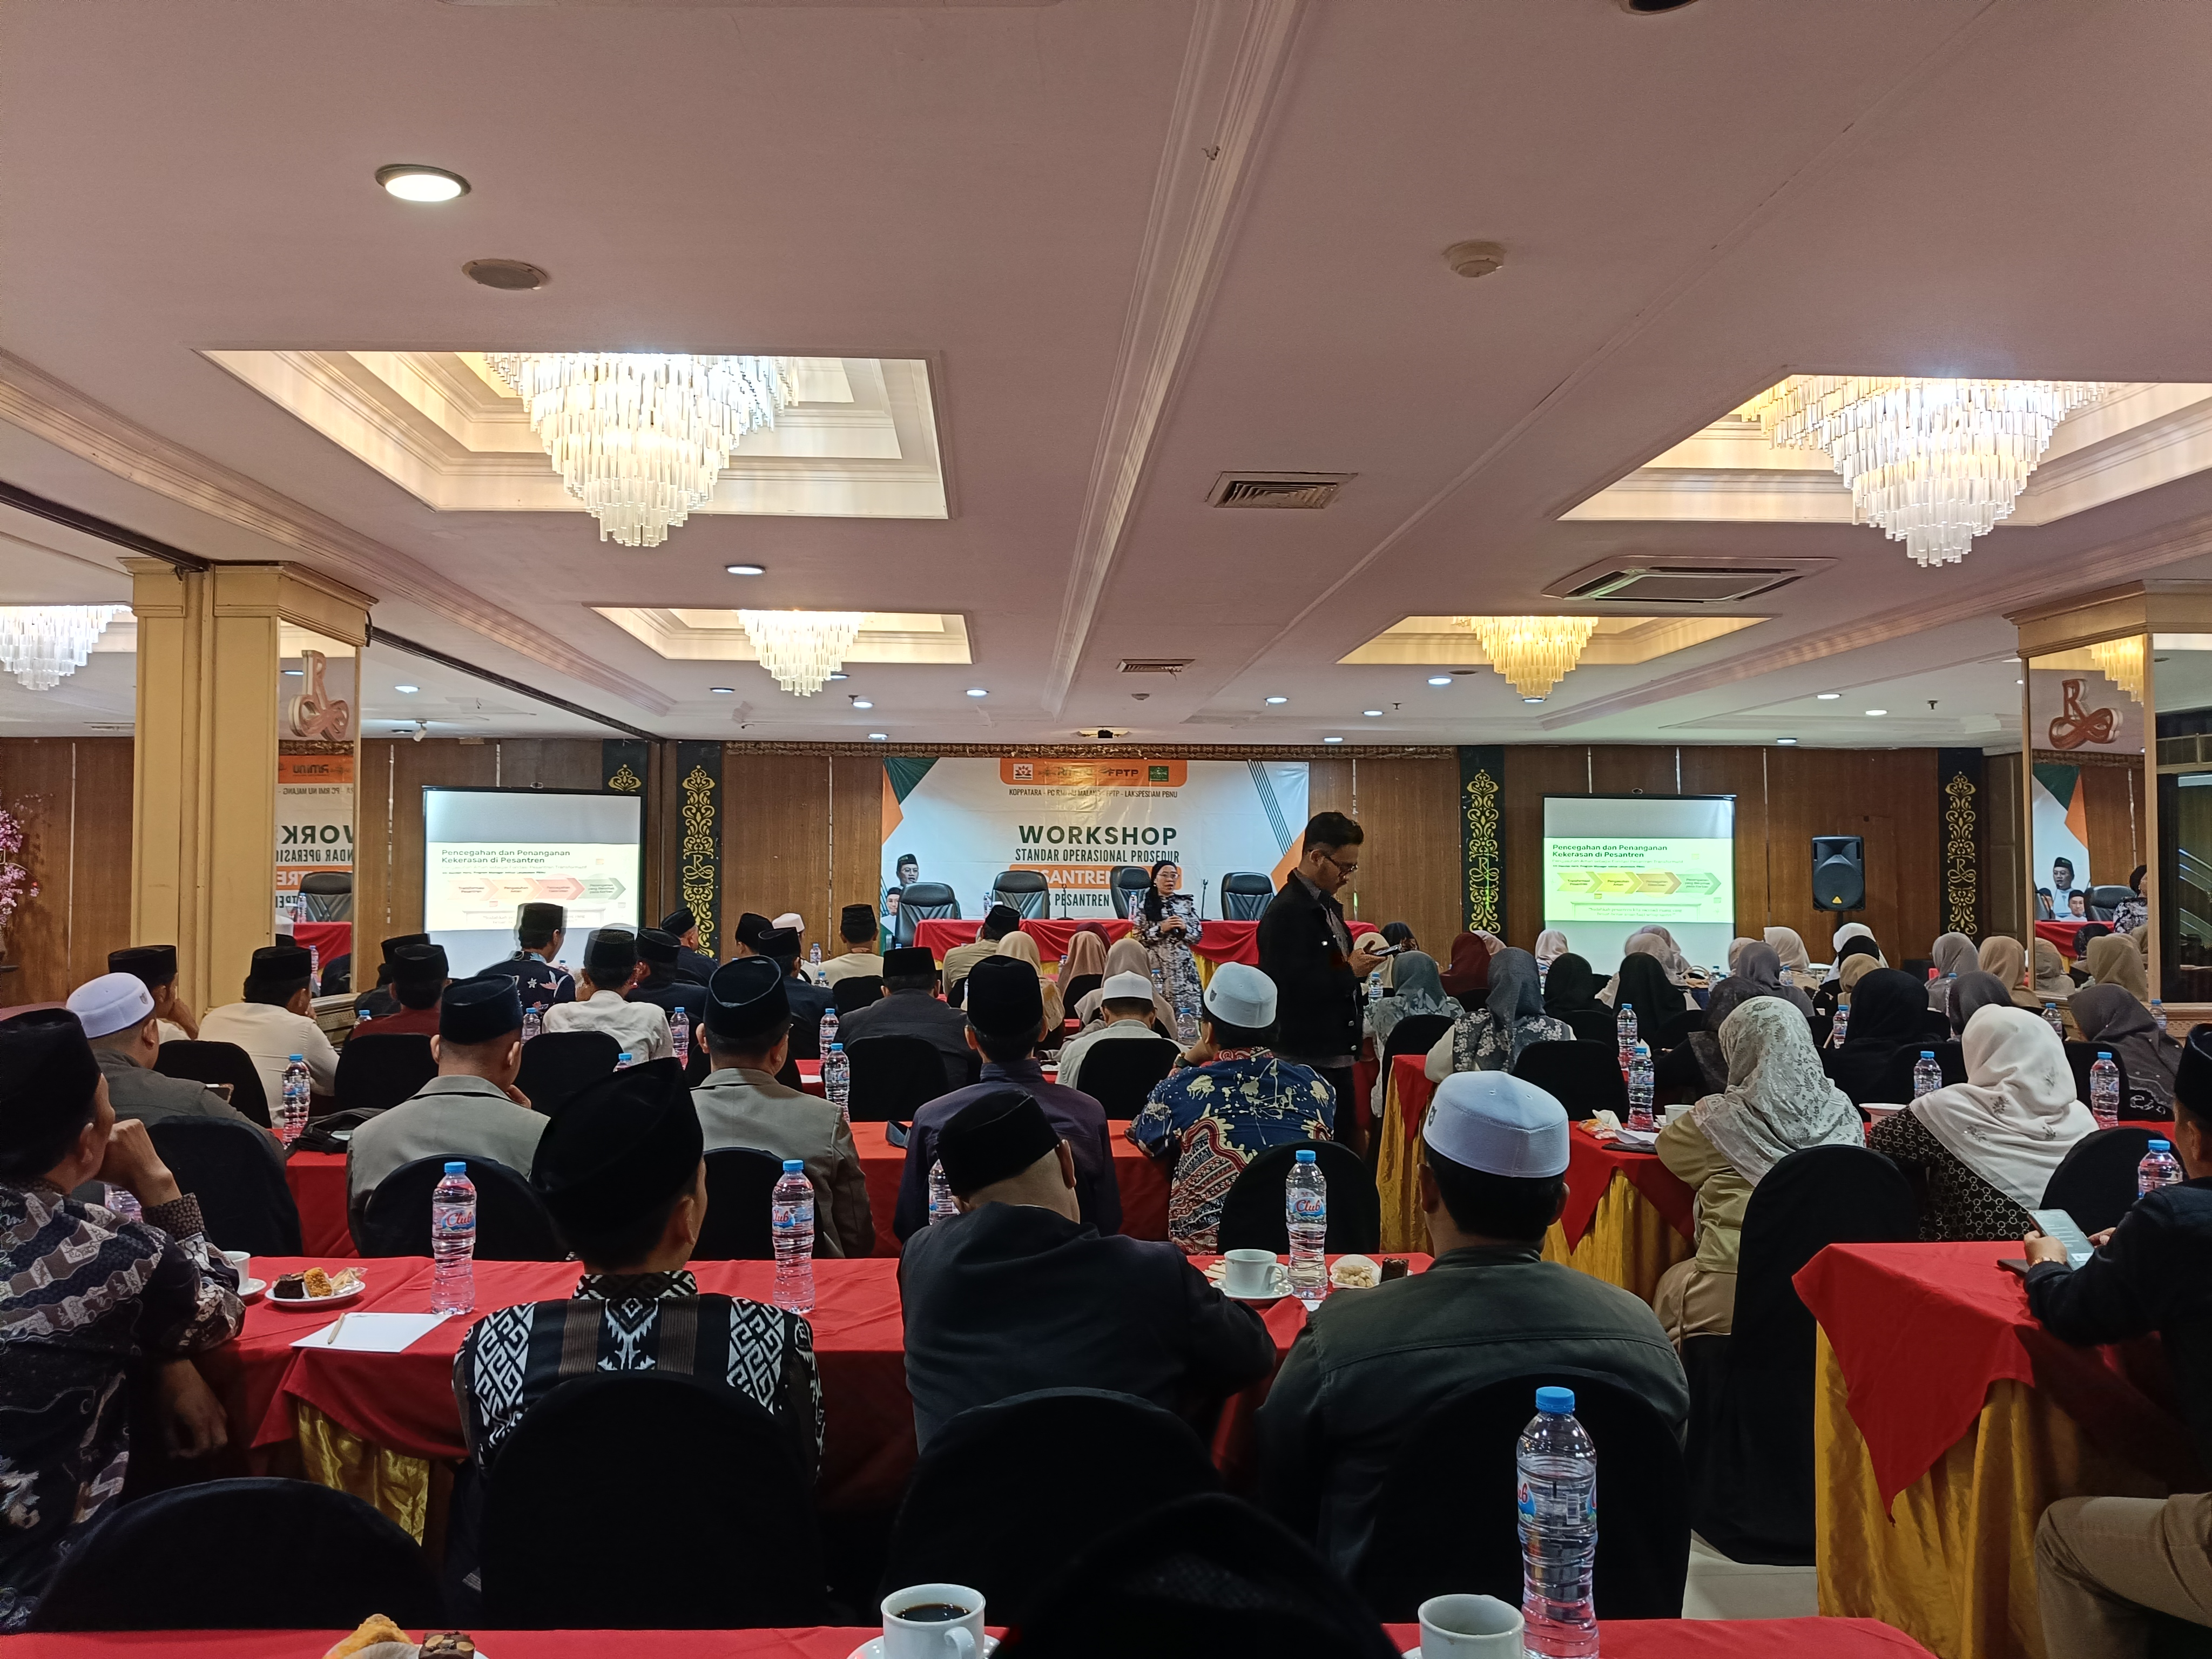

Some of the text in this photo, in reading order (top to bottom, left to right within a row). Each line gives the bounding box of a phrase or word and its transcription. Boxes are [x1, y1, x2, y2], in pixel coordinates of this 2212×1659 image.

[1019, 825, 1177, 846] WORKSHOP
[1015, 848, 1179, 863] STANDAR OPERASIONAL PROSEDUR
[1028, 869, 1111, 884] SANTRE
[1055, 893, 1110, 906] PESANTREN
[1296, 1199, 1320, 1212] Club
[446, 1212, 472, 1225] Club
